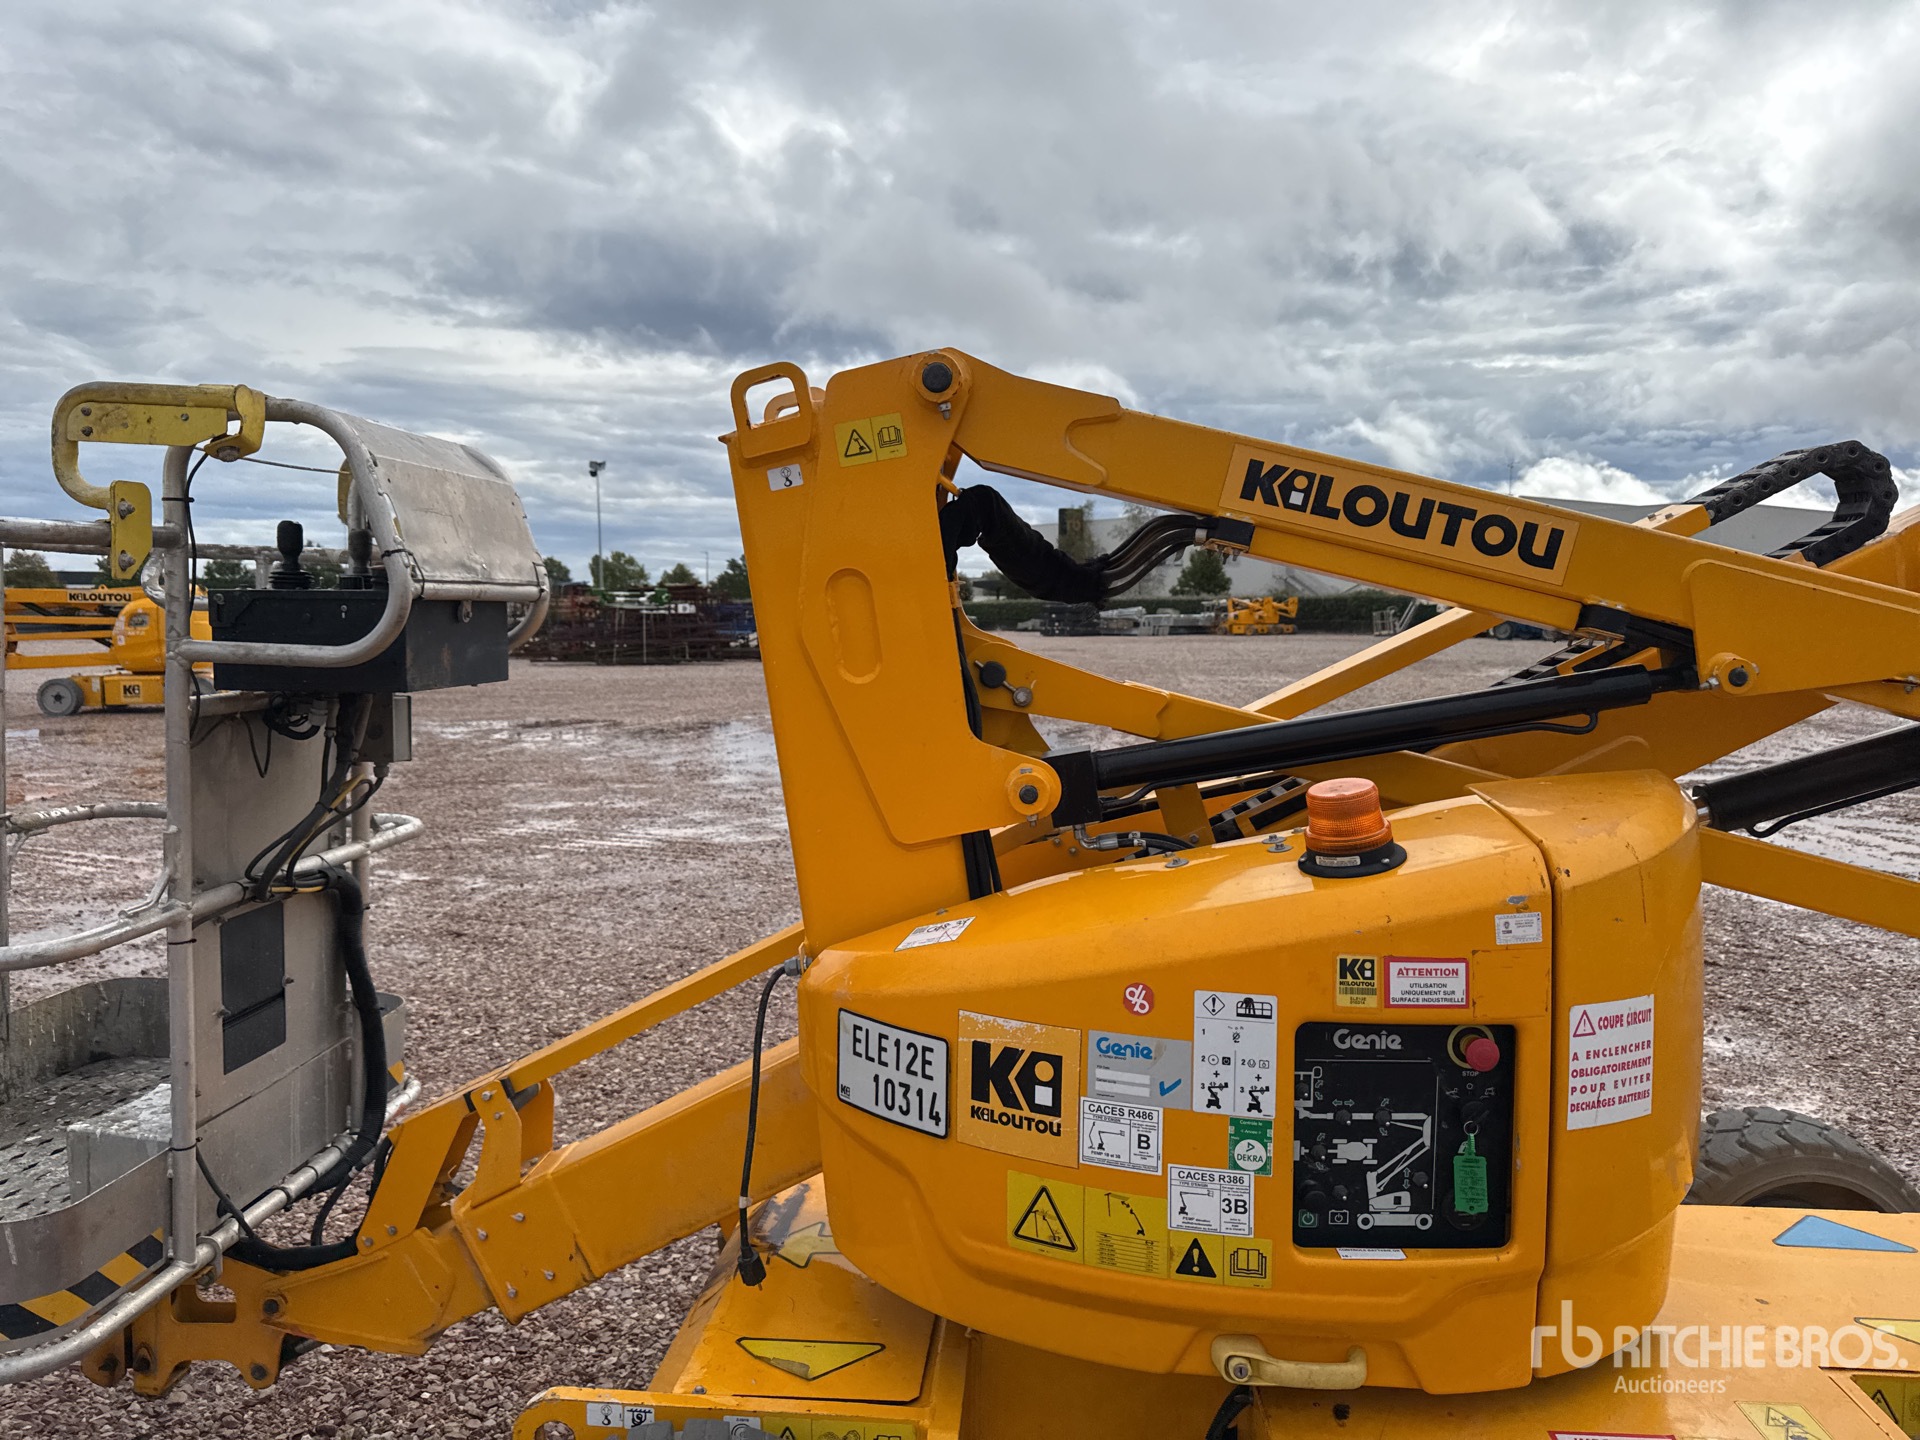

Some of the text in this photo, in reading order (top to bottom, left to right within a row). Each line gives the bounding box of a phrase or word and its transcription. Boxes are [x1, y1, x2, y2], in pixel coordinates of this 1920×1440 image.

[1397, 967, 1459, 977] ATTENTION
[1597, 1008, 1652, 1031] COUPE CIRCUIT
[1096, 1036, 1153, 1060] Genie
[1332, 1028, 1402, 1050] Genie
[853, 1024, 934, 1082] ELE12E
[1572, 1040, 1652, 1062] A ENCLENCHER
[1571, 1056, 1652, 1079] OBLIGATOIREMENT
[1570, 1072, 1651, 1096] POUR EVITER
[873, 1074, 942, 1127] 10314
[1570, 1088, 1650, 1113] DECHARGES BATTERIES
[1088, 1104, 1154, 1121] CACES R486
[1138, 1134, 1151, 1150] B
[1236, 1154, 1264, 1163] DEKRA
[1178, 1170, 1245, 1184] CACES R386
[1222, 1198, 1248, 1214] 3B
